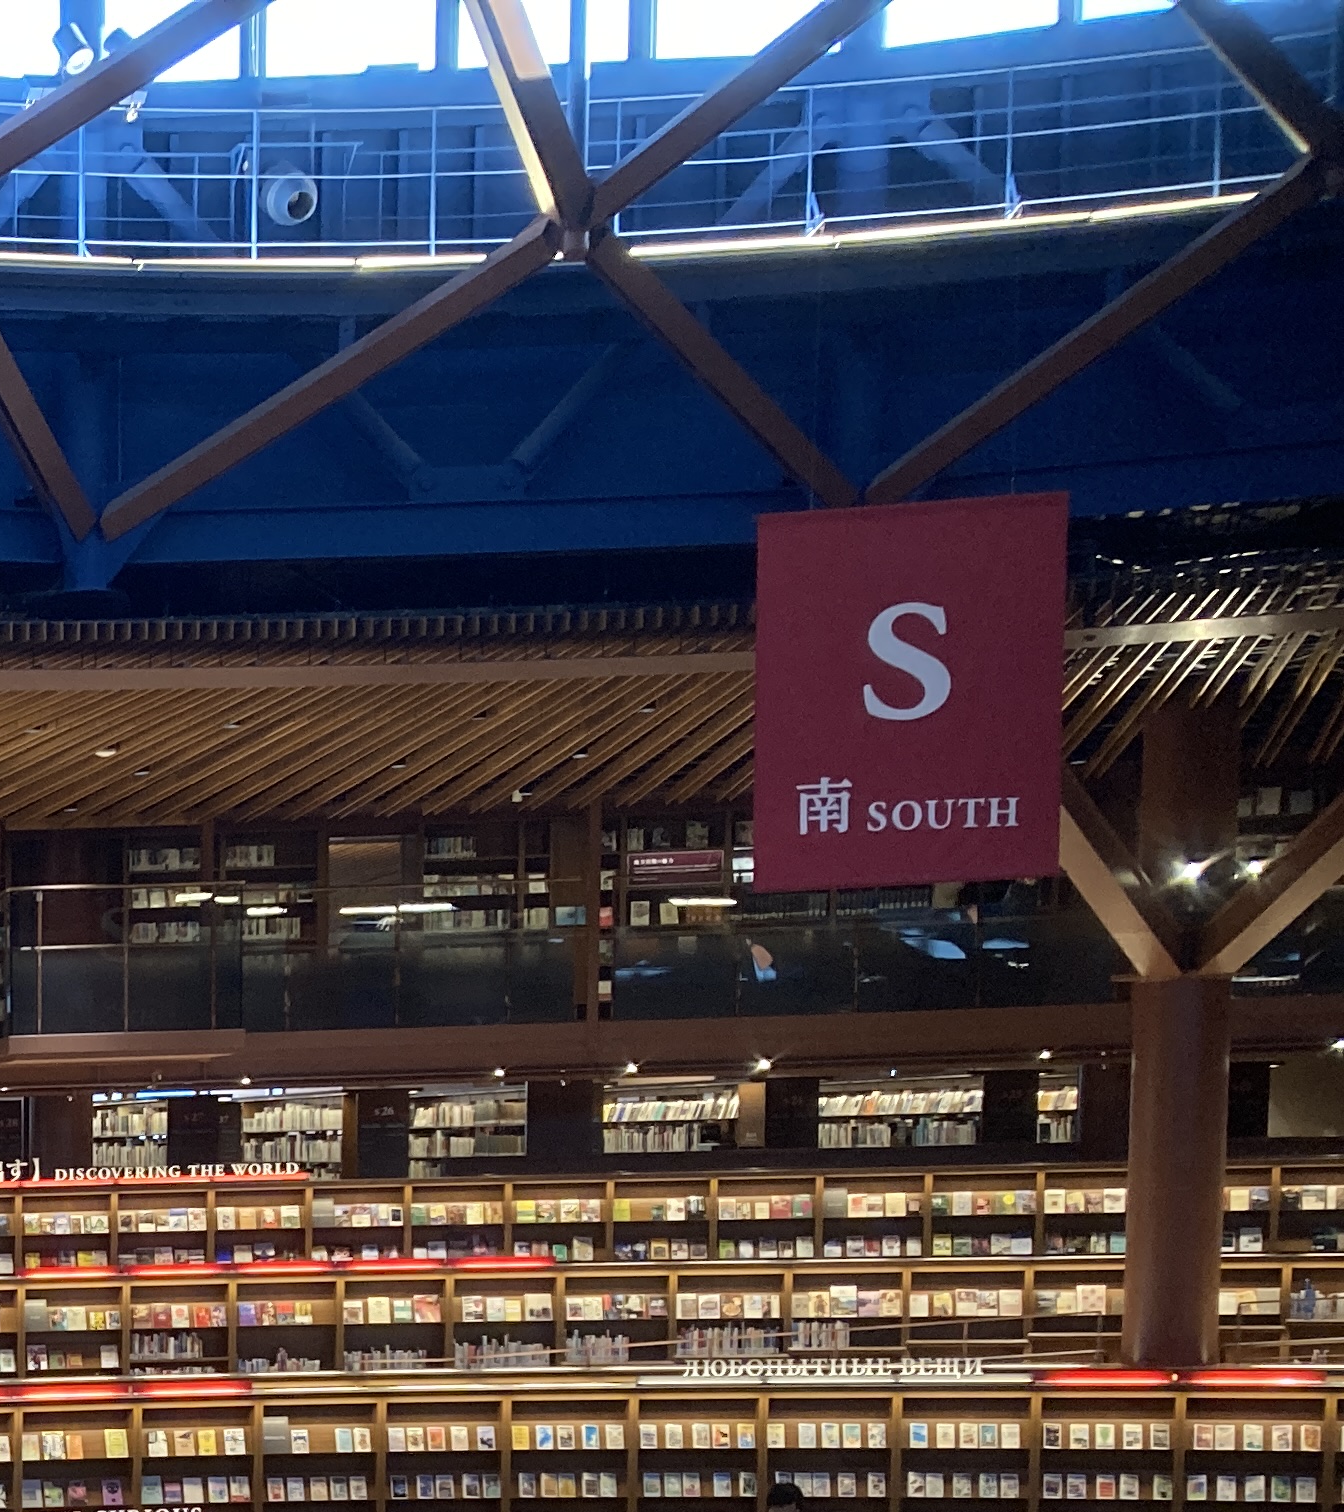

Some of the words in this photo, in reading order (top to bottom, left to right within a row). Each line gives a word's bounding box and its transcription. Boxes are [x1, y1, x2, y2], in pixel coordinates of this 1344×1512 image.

[863, 601, 952, 721] S
[796, 777, 852, 835] 南
[866, 796, 1020, 832] SOUTH
[54, 1165, 181, 1181] DISCOVERING
[188, 1163, 226, 1179] THE
[231, 1161, 300, 1177] WORLD
[683, 1358, 892, 1377] ЛЮБОПЫТНЫЕ
[899, 1358, 984, 1379] ВЕЩИ
